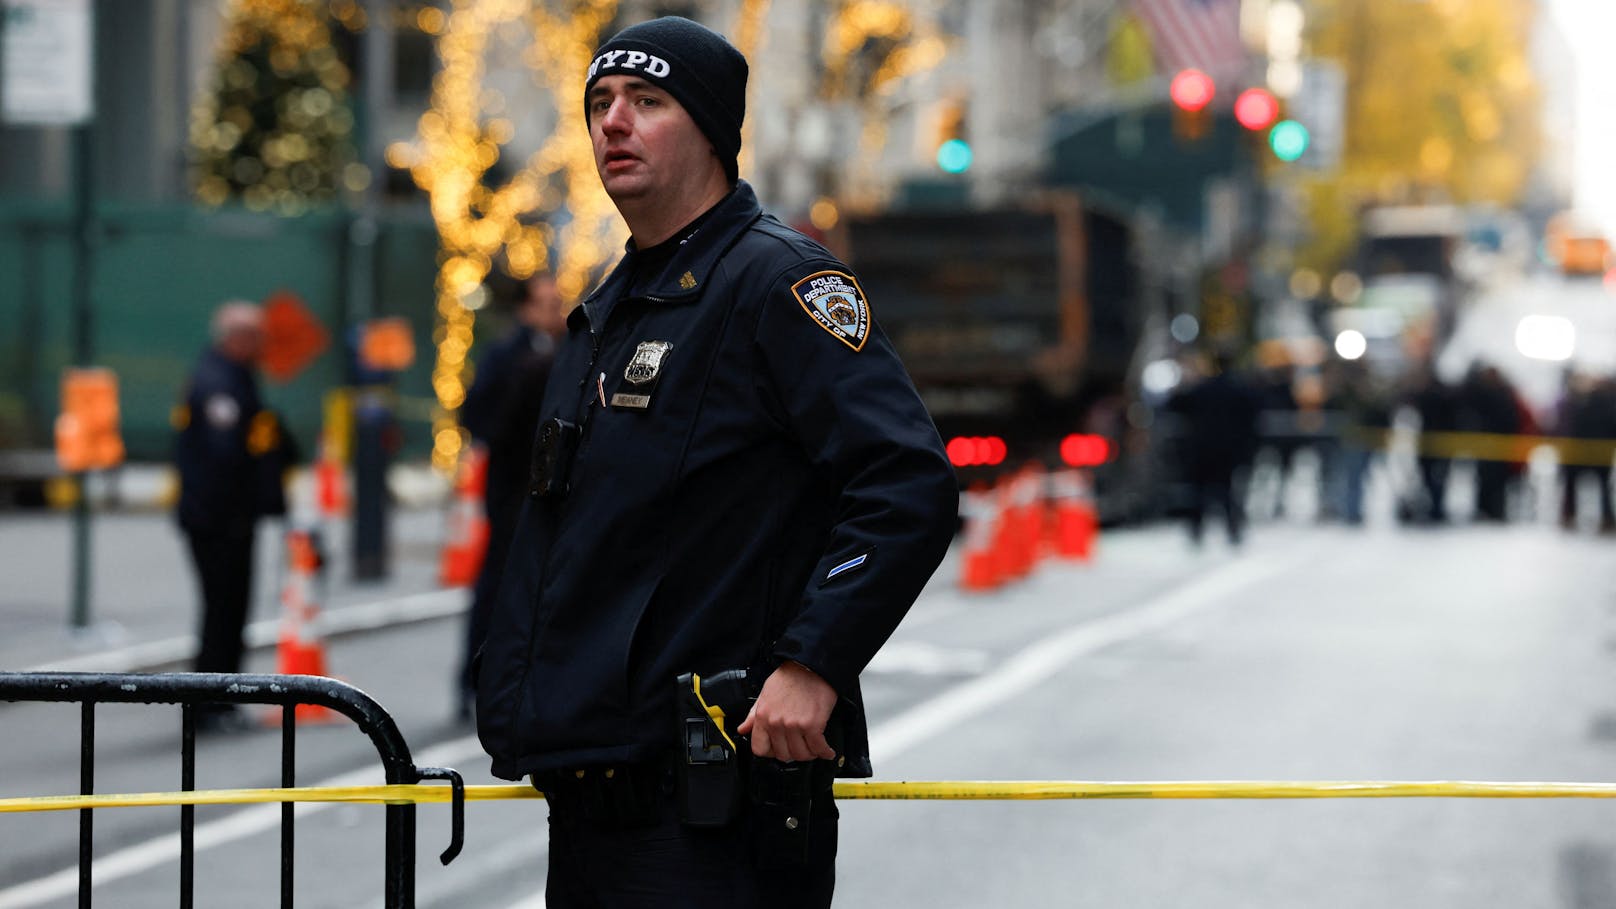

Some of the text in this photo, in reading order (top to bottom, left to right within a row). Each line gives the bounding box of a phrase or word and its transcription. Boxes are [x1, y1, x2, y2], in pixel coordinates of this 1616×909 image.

[586, 50, 670, 82] NYPD
[804, 285, 856, 302] DEPARTMENT
[810, 276, 843, 288] POLICE
[813, 310, 846, 337] CITY OF
[857, 300, 866, 340] NEW YORK
